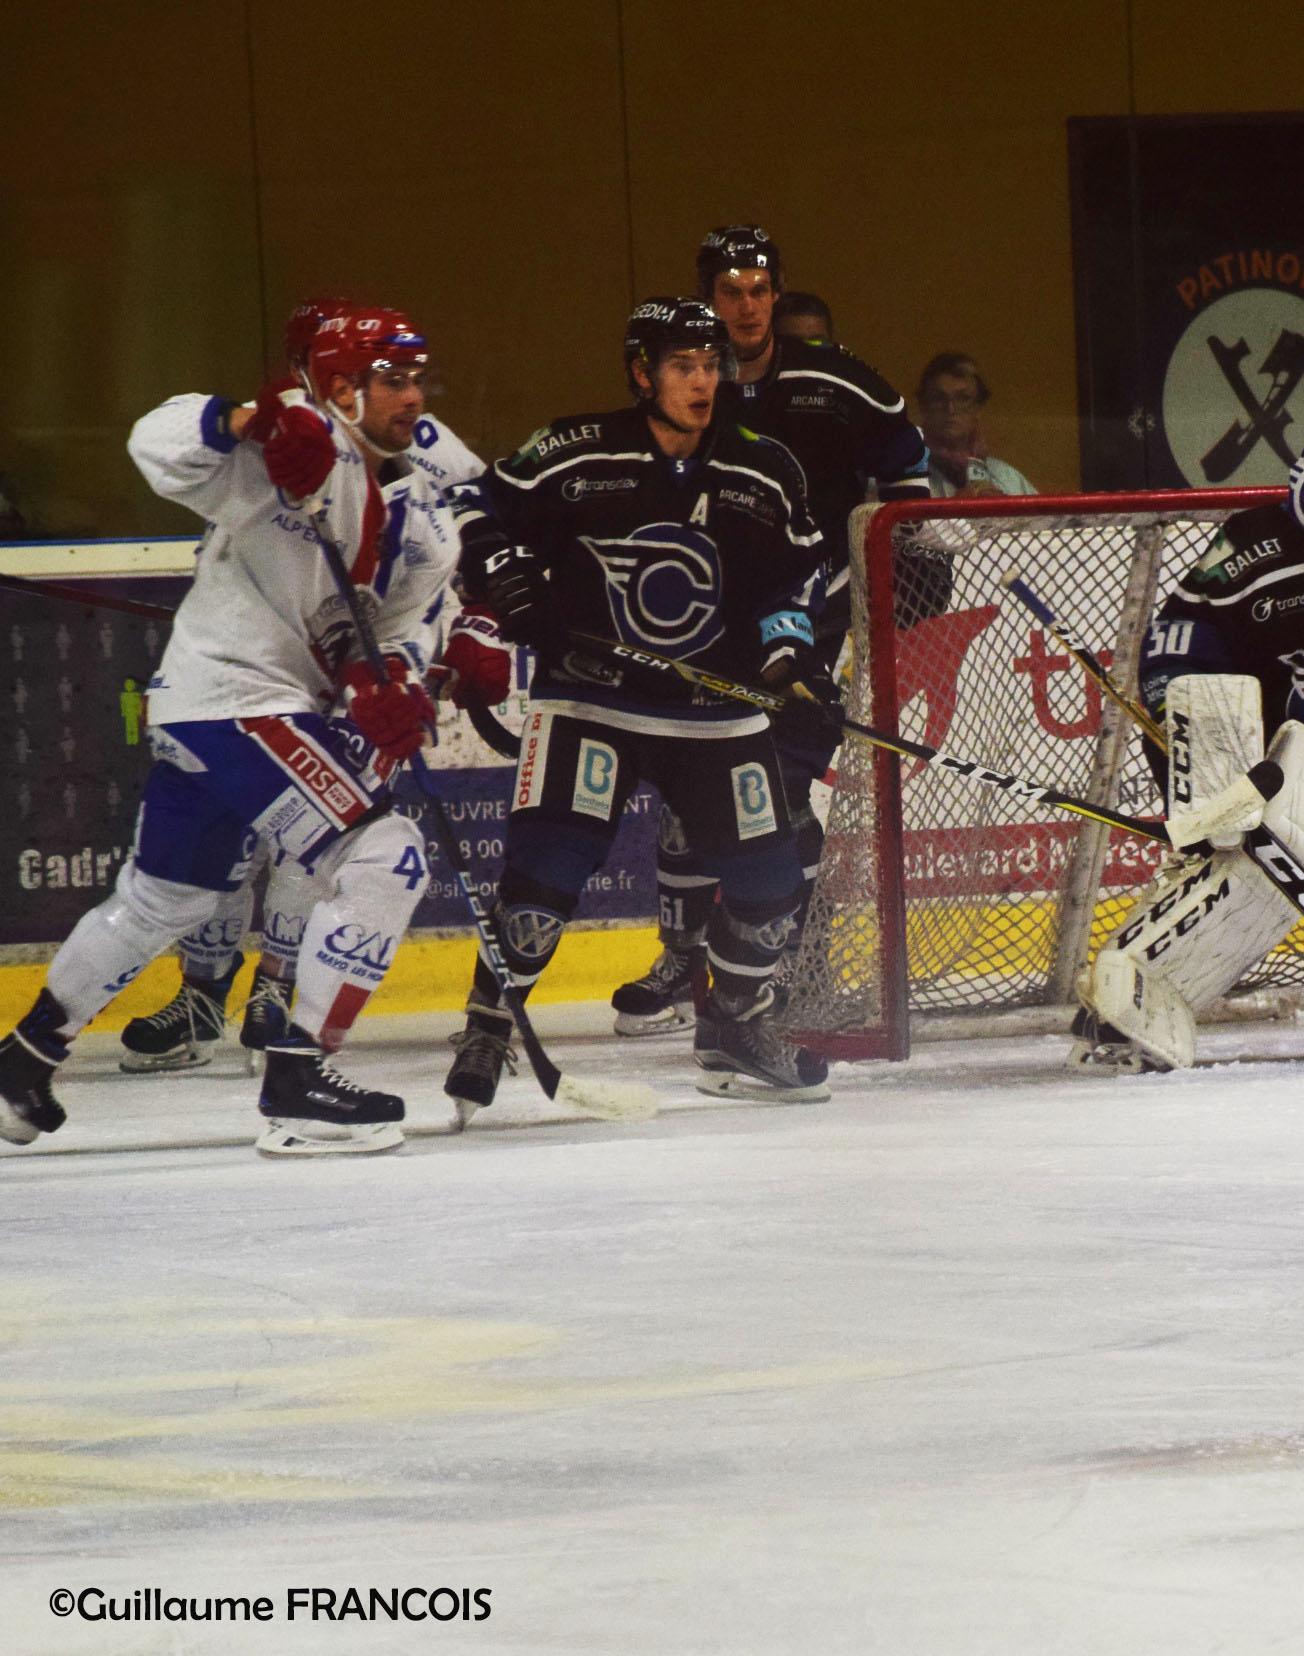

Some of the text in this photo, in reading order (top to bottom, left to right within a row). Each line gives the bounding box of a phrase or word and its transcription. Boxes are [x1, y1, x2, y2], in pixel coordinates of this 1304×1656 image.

[535, 424, 602, 457] BALLET
[675, 461, 684, 474] 5
[688, 492, 709, 527] A
[1224, 538, 1282, 578] BALLET
[612, 645, 672, 671] CCM
[1147, 620, 1195, 658] 50
[928, 752, 1050, 801] CCM
[1173, 711, 1192, 804] CCM
[391, 845, 425, 891] 4
[660, 894, 685, 932] 61
[1117, 859, 1213, 950] CCM
[1136, 878, 1230, 961] CCM
